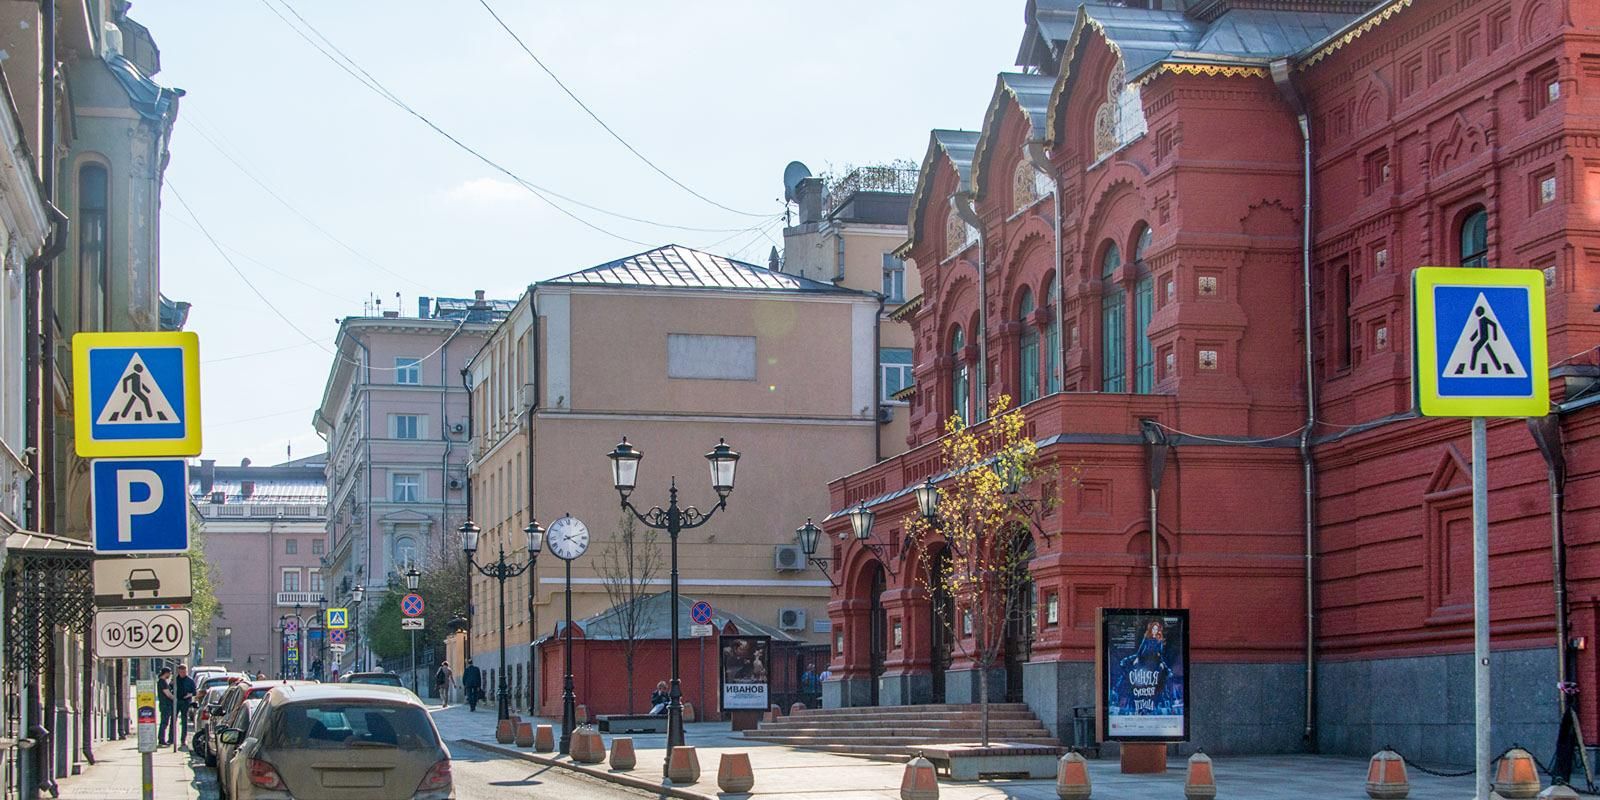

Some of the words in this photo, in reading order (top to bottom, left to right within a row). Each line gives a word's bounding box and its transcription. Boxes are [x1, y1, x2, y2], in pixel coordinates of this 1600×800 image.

[117, 469, 164, 542] P
[106, 628, 121, 641] 10
[126, 626, 144, 642] 15
[151, 624, 178, 643] 20
[1129, 668, 1160, 686] СИНЯЯ
[726, 685, 764, 693] ИВАНОВ
